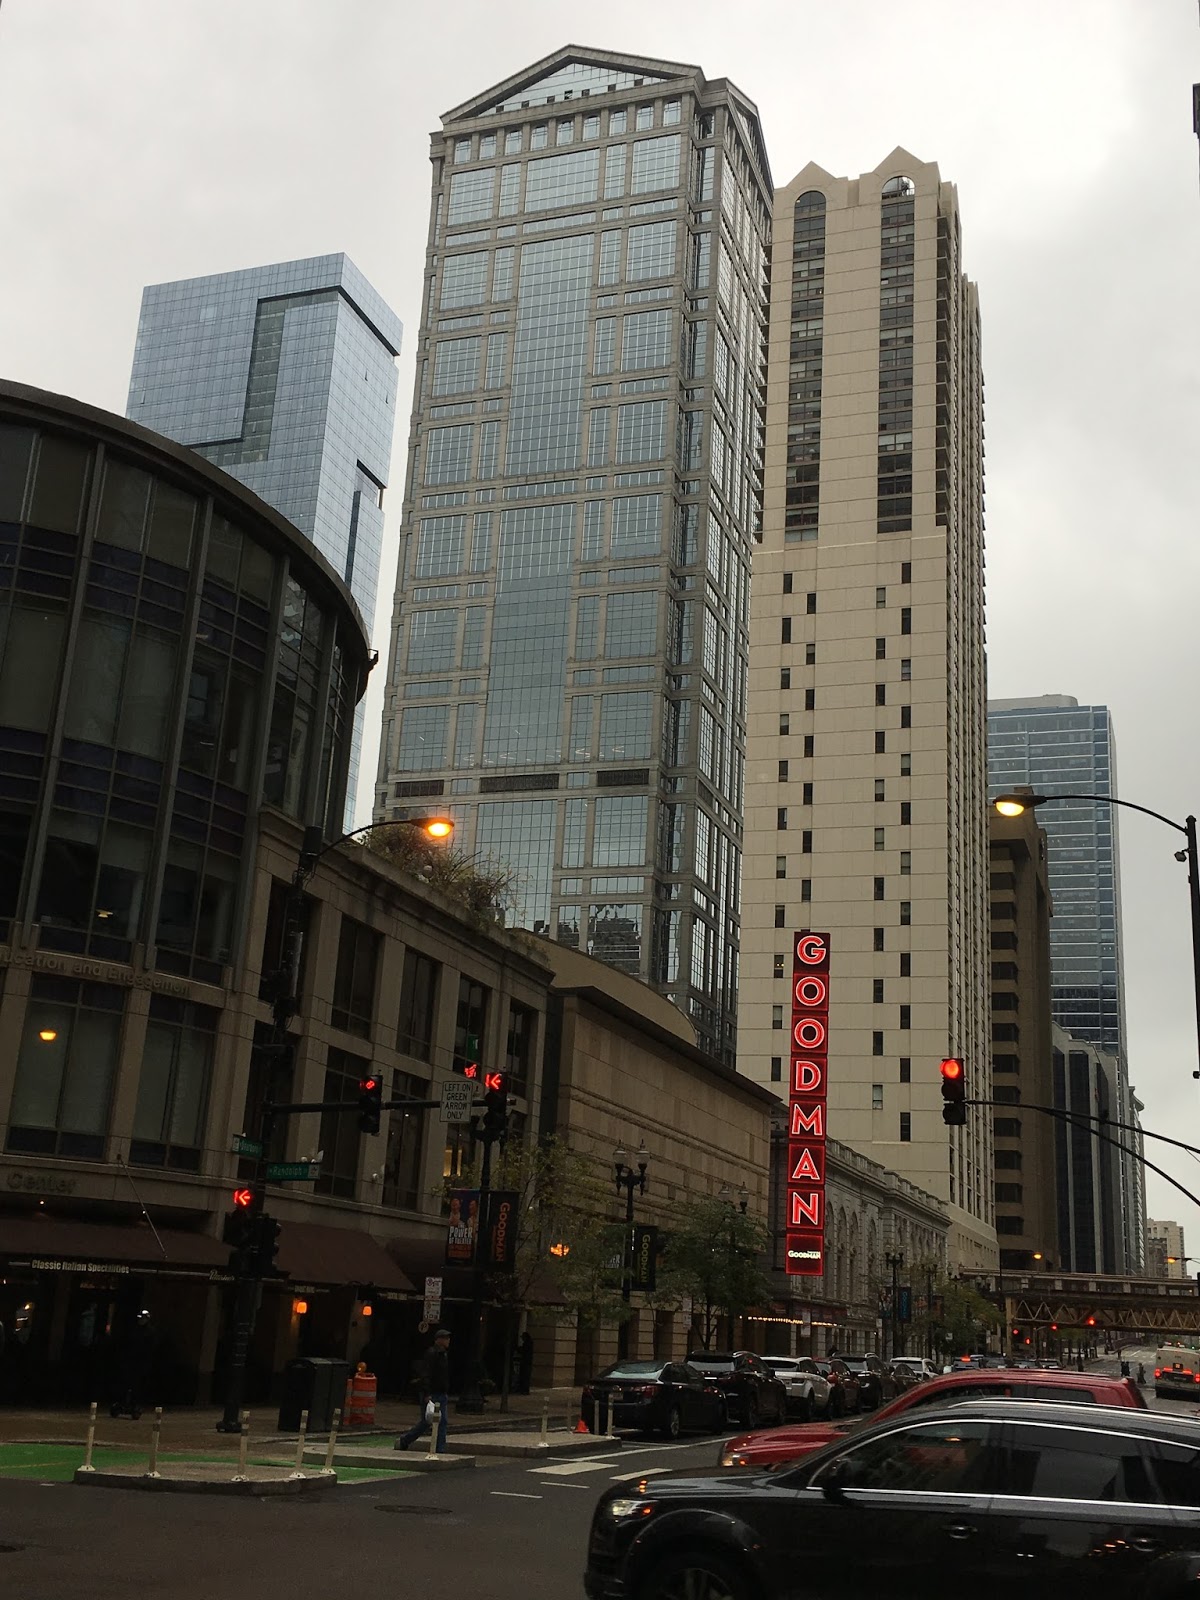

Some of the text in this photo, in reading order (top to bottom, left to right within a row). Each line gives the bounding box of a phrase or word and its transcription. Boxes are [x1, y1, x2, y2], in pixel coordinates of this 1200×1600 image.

[73, 962, 103, 976] and
[106, 967, 192, 994] Engagemen
[792, 934, 827, 1225] GOODMAN
[444, 1083, 471, 1091] LEFT ON
[446, 1092, 467, 1101] GREEN
[445, 1101, 467, 1110] ARROW
[447, 1111, 463, 1119] ONLY
[6, 1172, 77, 1194] Center
[449, 1226, 473, 1238] POWER
[495, 1202, 511, 1262] GOODMAN
[640, 1234, 651, 1283] GOODMAN
[31, 1259, 61, 1270] Classic
[62, 1261, 87, 1272] Italian
